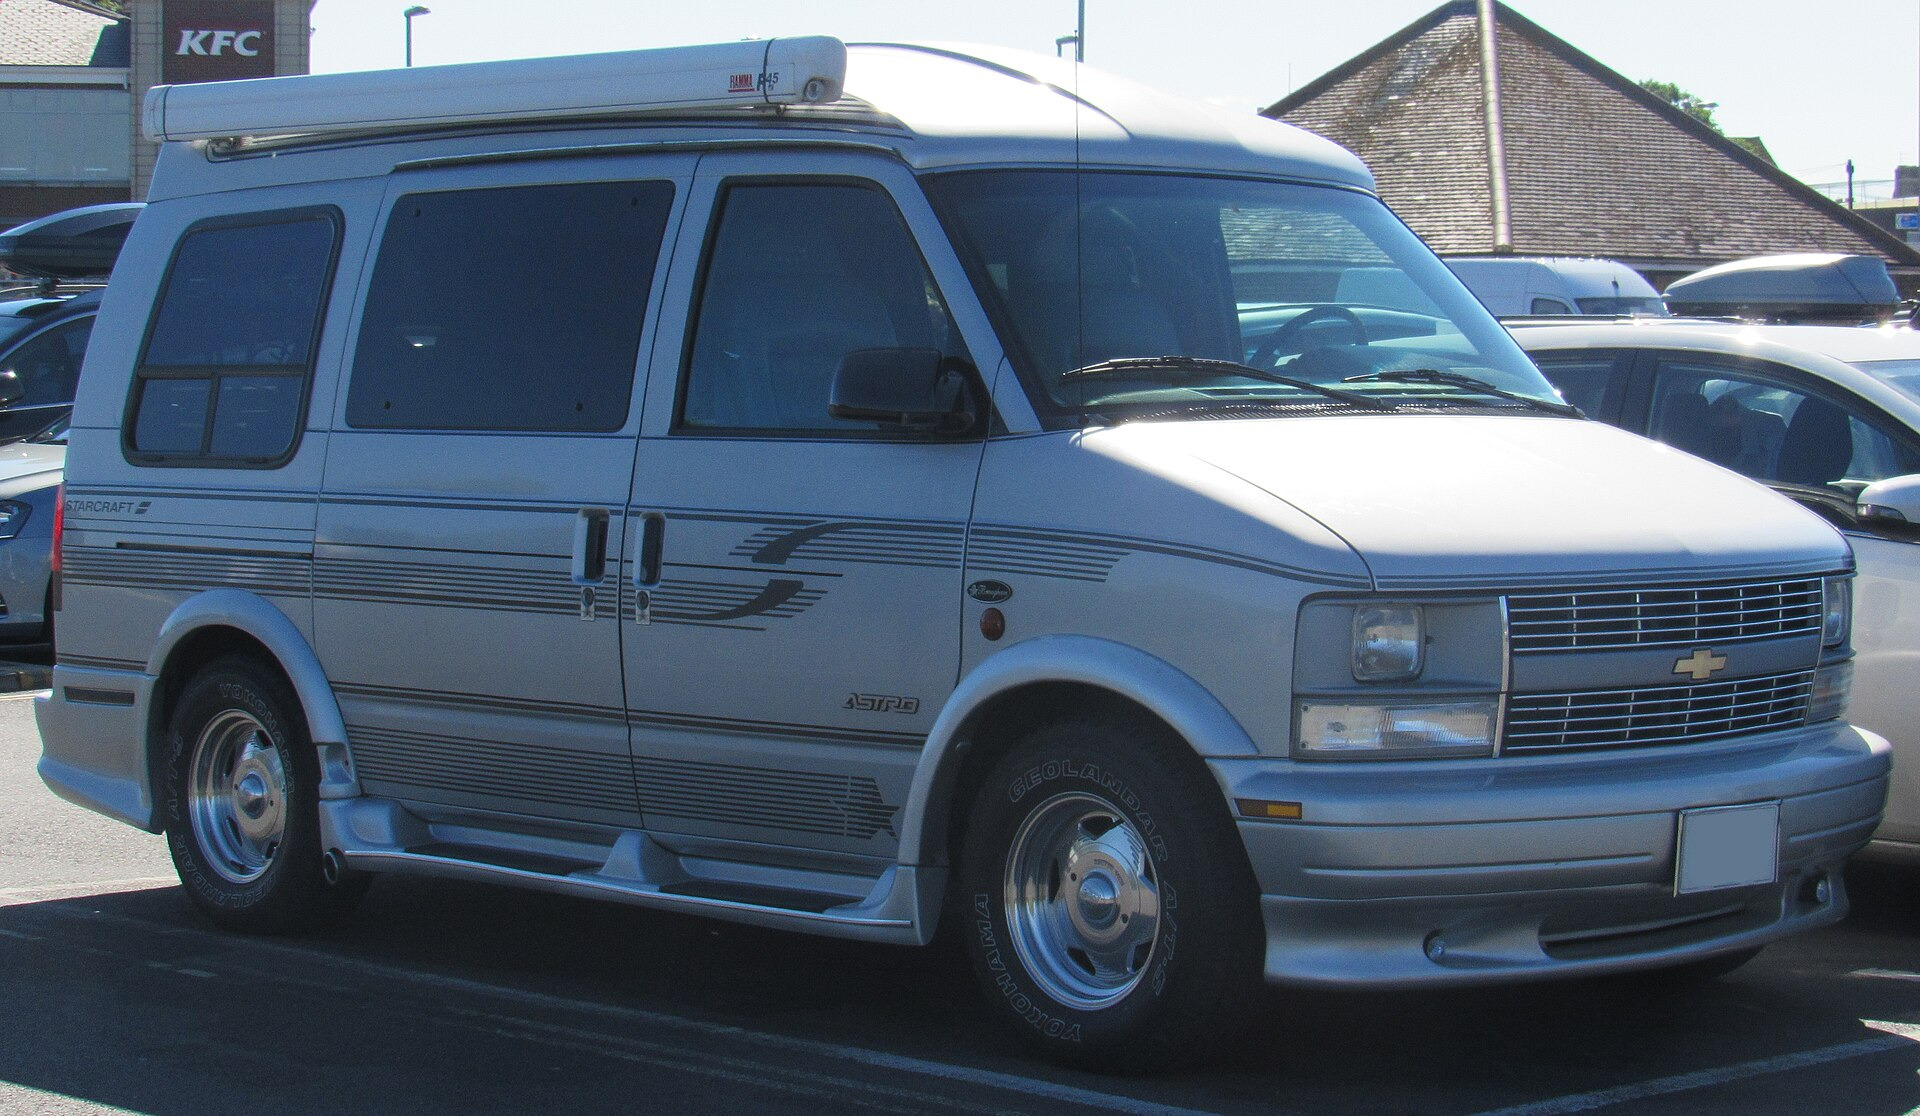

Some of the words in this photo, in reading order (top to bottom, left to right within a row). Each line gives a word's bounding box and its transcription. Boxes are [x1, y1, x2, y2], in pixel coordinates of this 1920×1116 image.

[175, 29, 262, 56] KFC
[65, 500, 135, 513] STARCRAFT
[841, 693, 920, 714] ASTRO
[219, 682, 297, 796] YOKOHAMA
[1008, 759, 1168, 862] GEOLANDAR
[974, 893, 1082, 1042] YOKOHAMA
